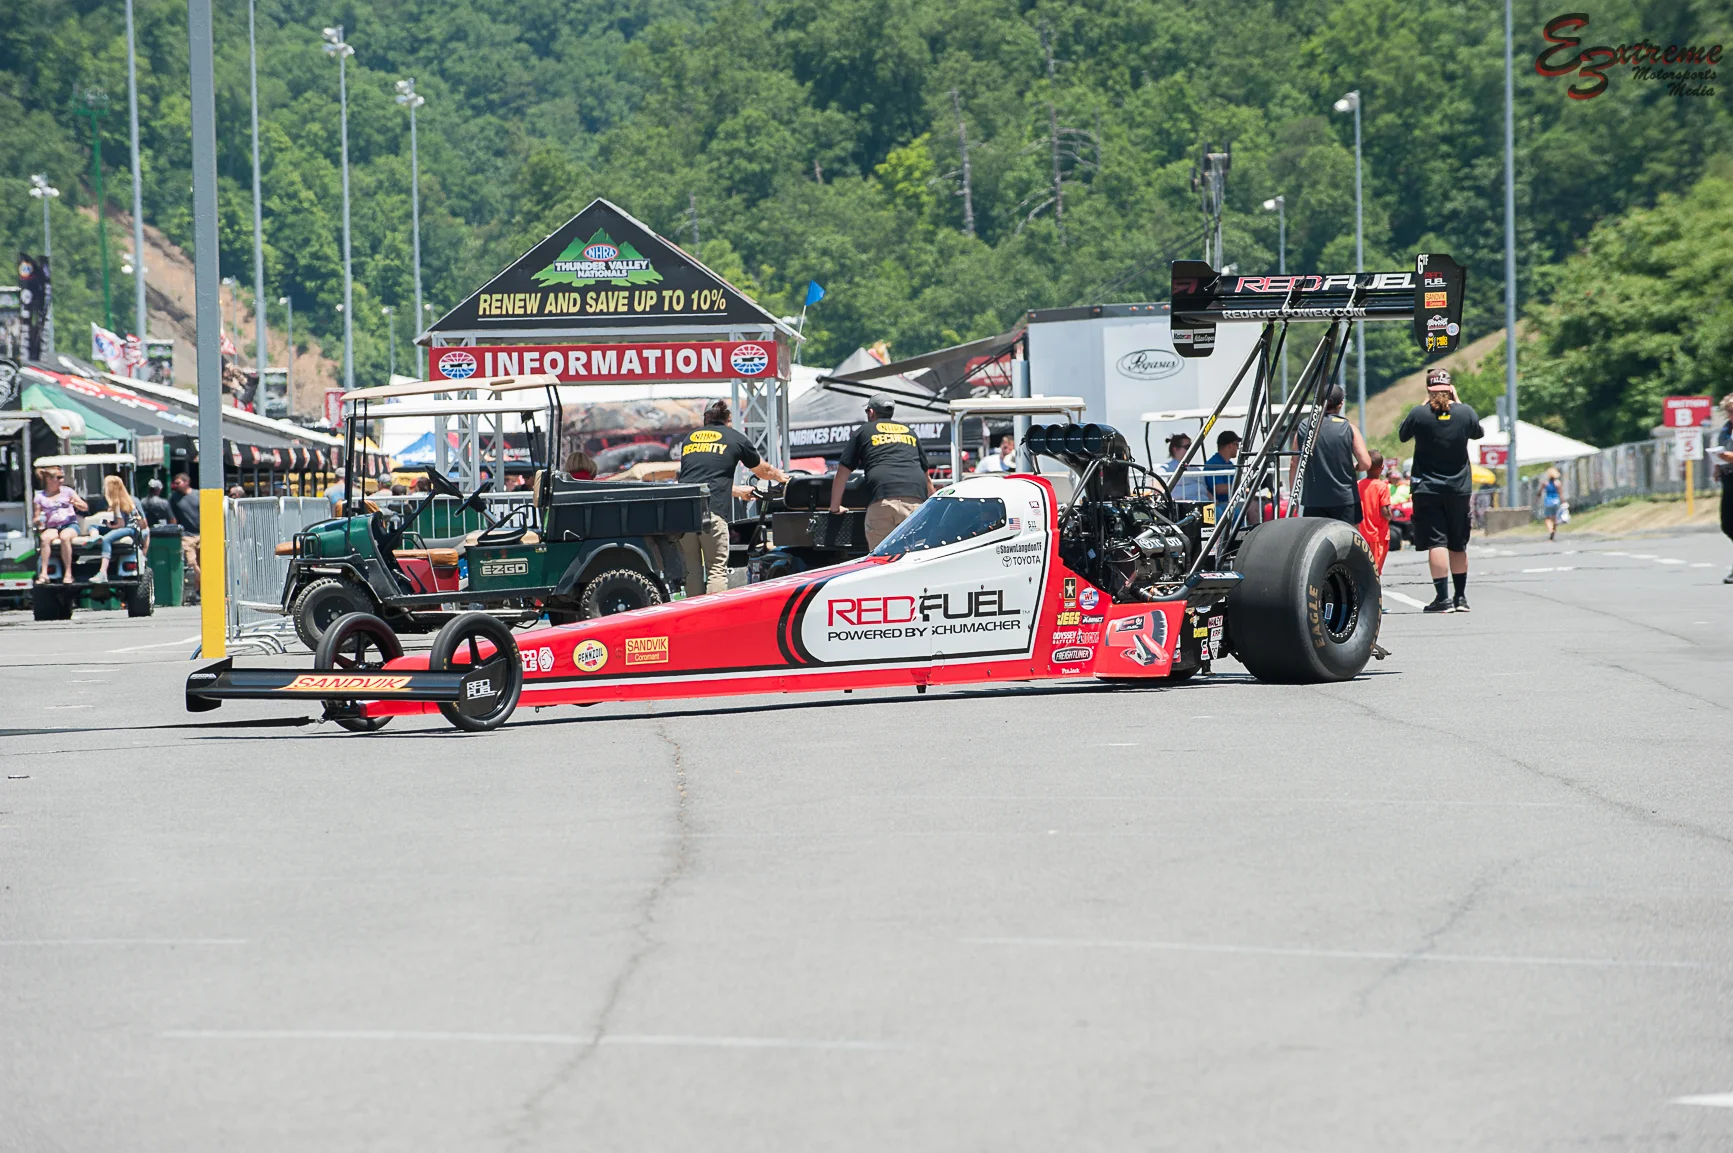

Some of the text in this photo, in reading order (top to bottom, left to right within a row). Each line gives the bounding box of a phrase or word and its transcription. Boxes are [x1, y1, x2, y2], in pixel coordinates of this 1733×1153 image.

[585, 247, 614, 260] NHRA
[554, 260, 648, 272] THUNDER VALLEY
[576, 269, 627, 278] NATIONALS
[478, 287, 727, 316] RENEW AND SAVE UP TO 10%
[1425, 293, 1446, 301] SANDVIK
[1221, 308, 1366, 319] REDFUELPOWER.COM
[484, 347, 723, 378] INFORMATION
[1128, 352, 1176, 374] Pegasus
[1675, 408, 1693, 427] B
[829, 425, 851, 443] FOR
[871, 433, 917, 448] SECURITY
[682, 443, 727, 457] SECURITY
[1486, 451, 1498, 465] C
[1013, 556, 1041, 565] TOYOTA
[828, 595, 916, 627] RED
[918, 590, 1020, 622] FUEL
[1057, 612, 1080, 625] JEGS
[1309, 585, 1325, 648] EAGLE
[828, 620, 1020, 641] POWERED BY SCHUMACHER
[1052, 631, 1077, 640] ODYSSEY
[626, 638, 667, 651] SANDVIK
[577, 649, 604, 663] PENNZOIL
[634, 653, 660, 662] Coromant
[1056, 650, 1089, 660] FREIGHTLINER
[298, 677, 404, 688] SANDVIK
